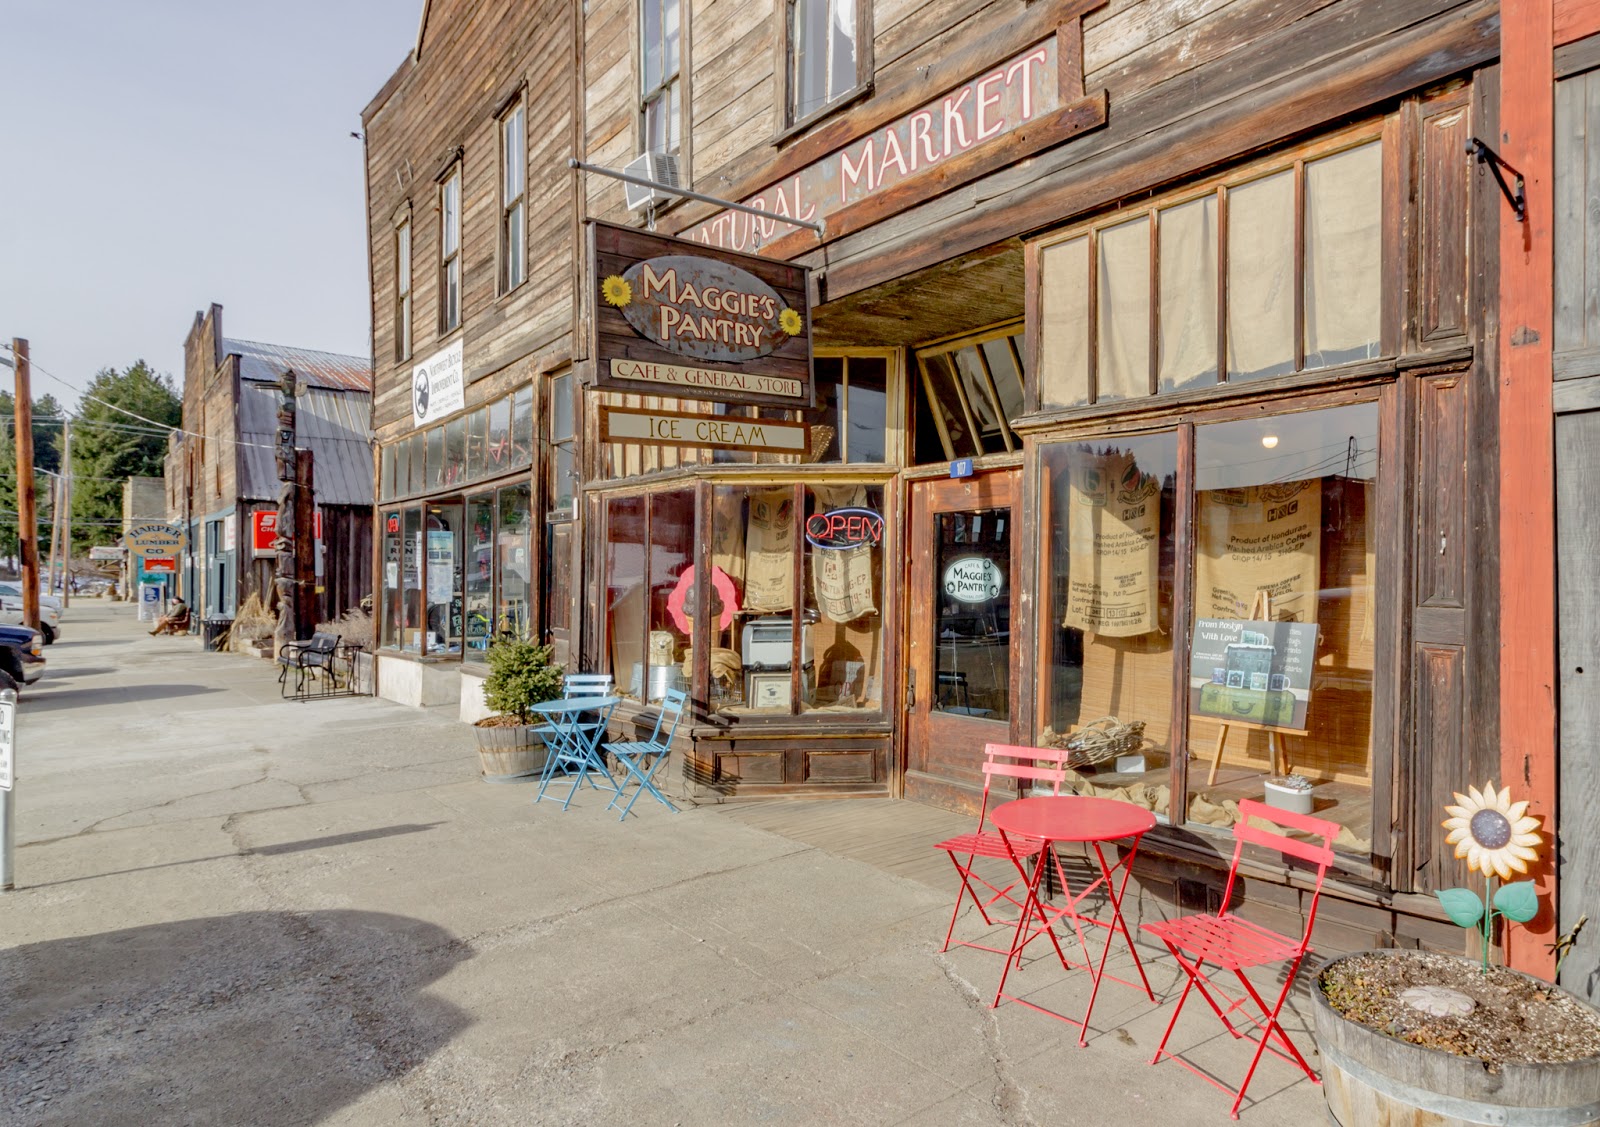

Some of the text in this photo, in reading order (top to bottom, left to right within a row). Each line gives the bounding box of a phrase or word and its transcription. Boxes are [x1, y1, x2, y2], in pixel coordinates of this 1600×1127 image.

[839, 47, 1048, 205] MARKET
[642, 263, 775, 320] MAGGIE'S
[660, 304, 764, 348] PANTRY
[616, 362, 661, 380] CAFE
[666, 367, 678, 382] &
[685, 369, 752, 390] GENERAL
[757, 378, 798, 395] STORE
[649, 418, 767, 446] ICE CREAM
[956, 462, 967, 476] 107
[964, 484, 972, 496] 8
[129, 525, 182, 539] HARPER
[806, 513, 882, 541] OPEN
[1230, 523, 1307, 545] Product of Honduras
[1256, 543, 1284, 553] Arabica
[1285, 531, 1313, 546] Coffee
[953, 567, 992, 582] MAGGIE'S
[957, 580, 988, 593] PANTRY
[1198, 620, 1244, 633] From Roslyn
[1201, 631, 1238, 642] With Love
